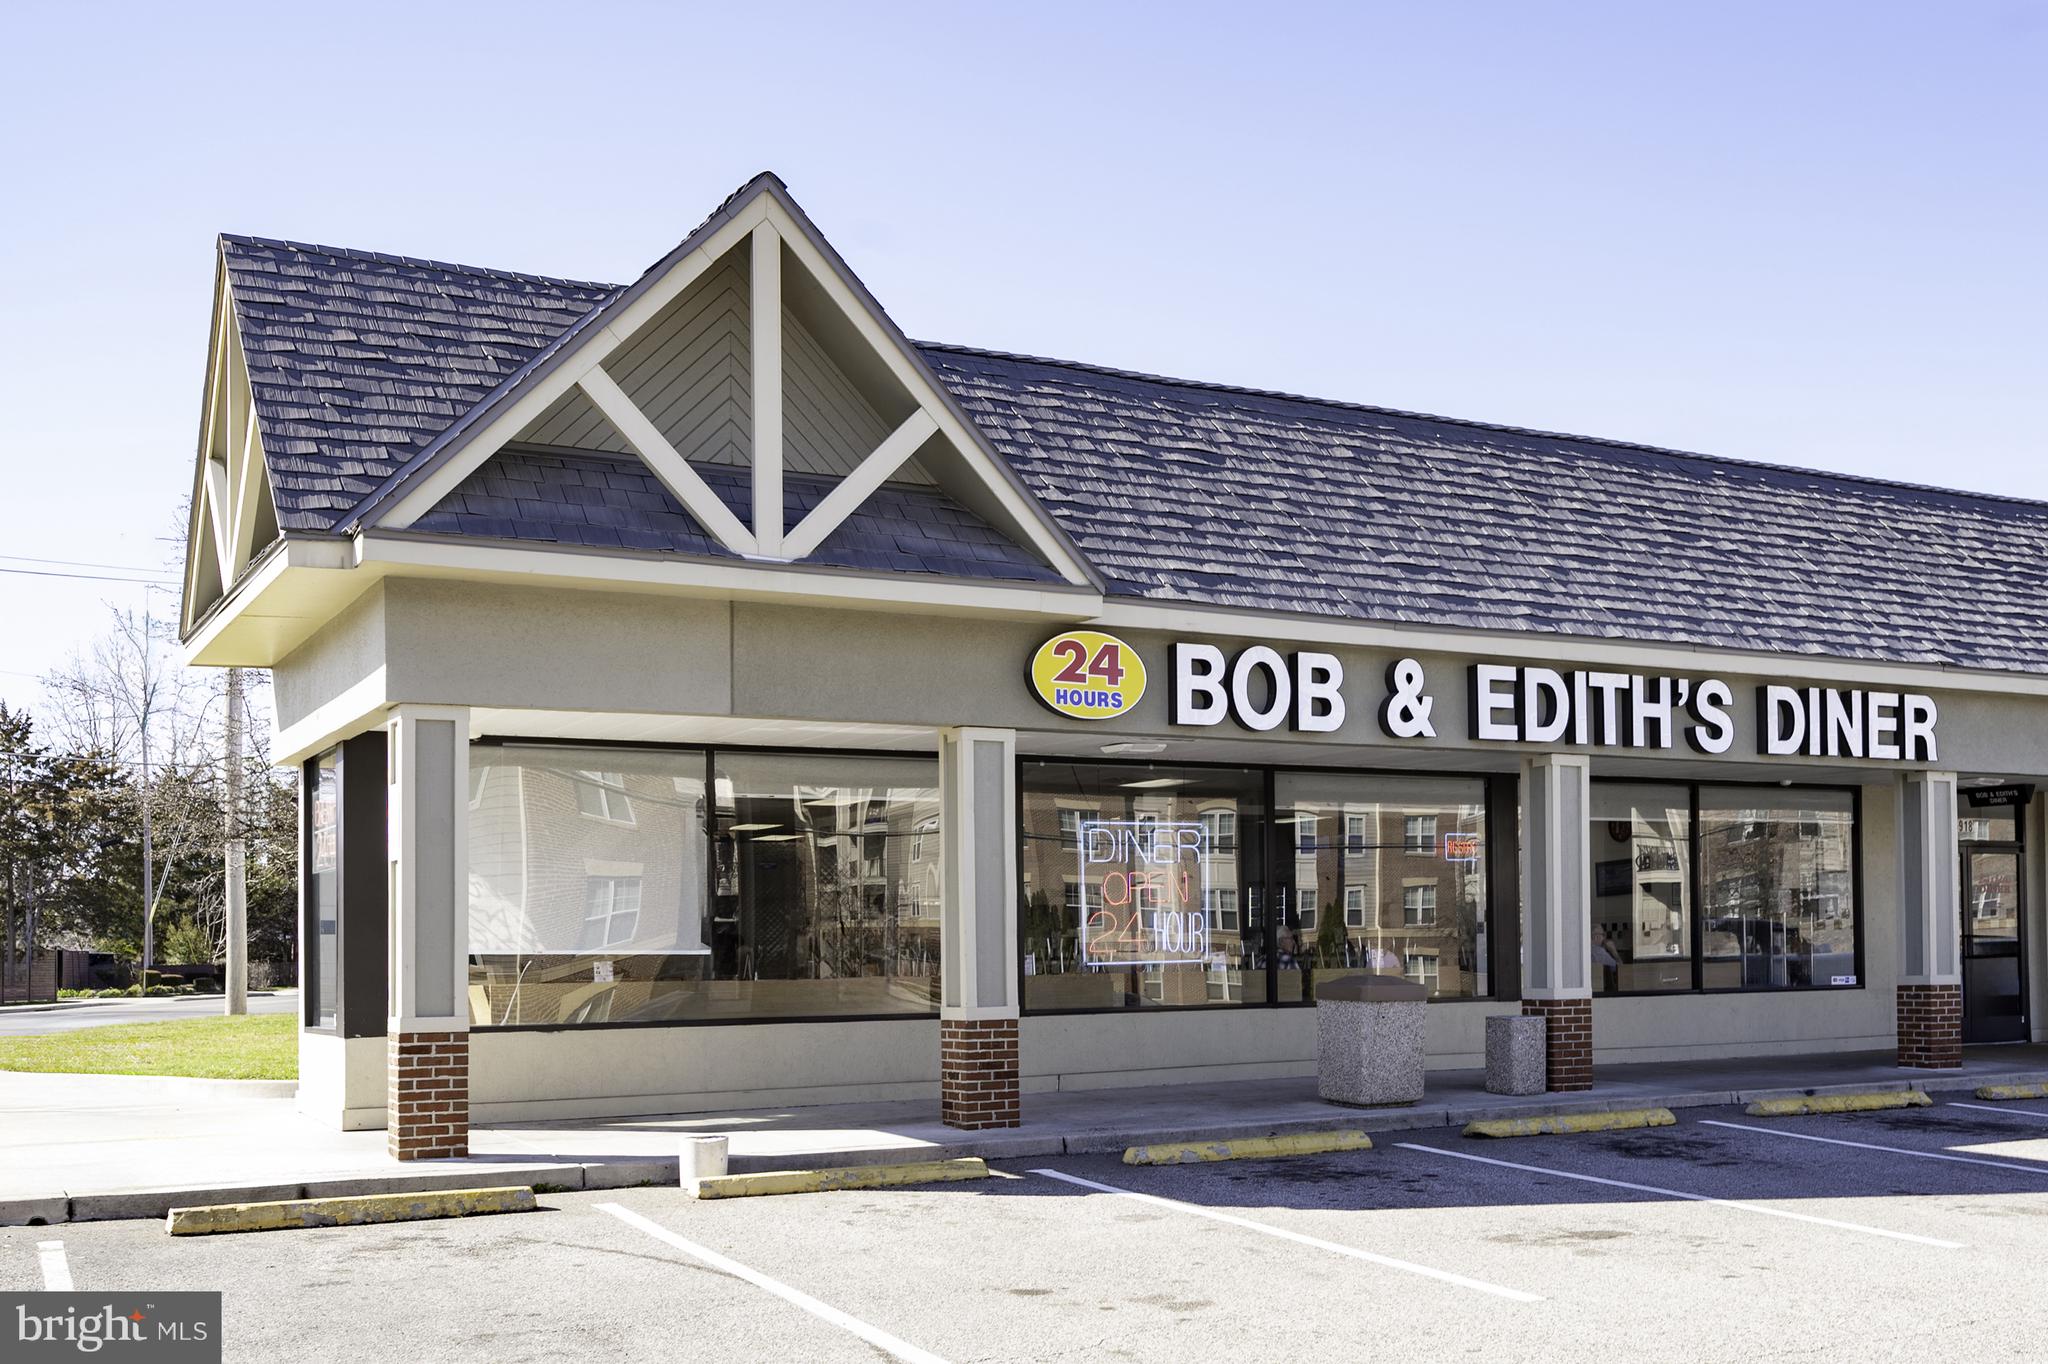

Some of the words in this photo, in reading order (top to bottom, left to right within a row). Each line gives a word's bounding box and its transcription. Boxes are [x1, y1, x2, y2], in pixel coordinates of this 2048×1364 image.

[1051, 638, 1125, 687] 24
[1055, 688, 1123, 709] HOURS
[1170, 642, 1347, 732] BOB
[1382, 658, 1437, 738] &
[1470, 664, 1734, 754] EDITH'S
[1760, 685, 1938, 762] DINER
[1088, 828, 1201, 864] DINER
[1103, 871, 1189, 906] OPEN
[1087, 910, 1148, 954] 24
[1153, 911, 1204, 953] HOUR
